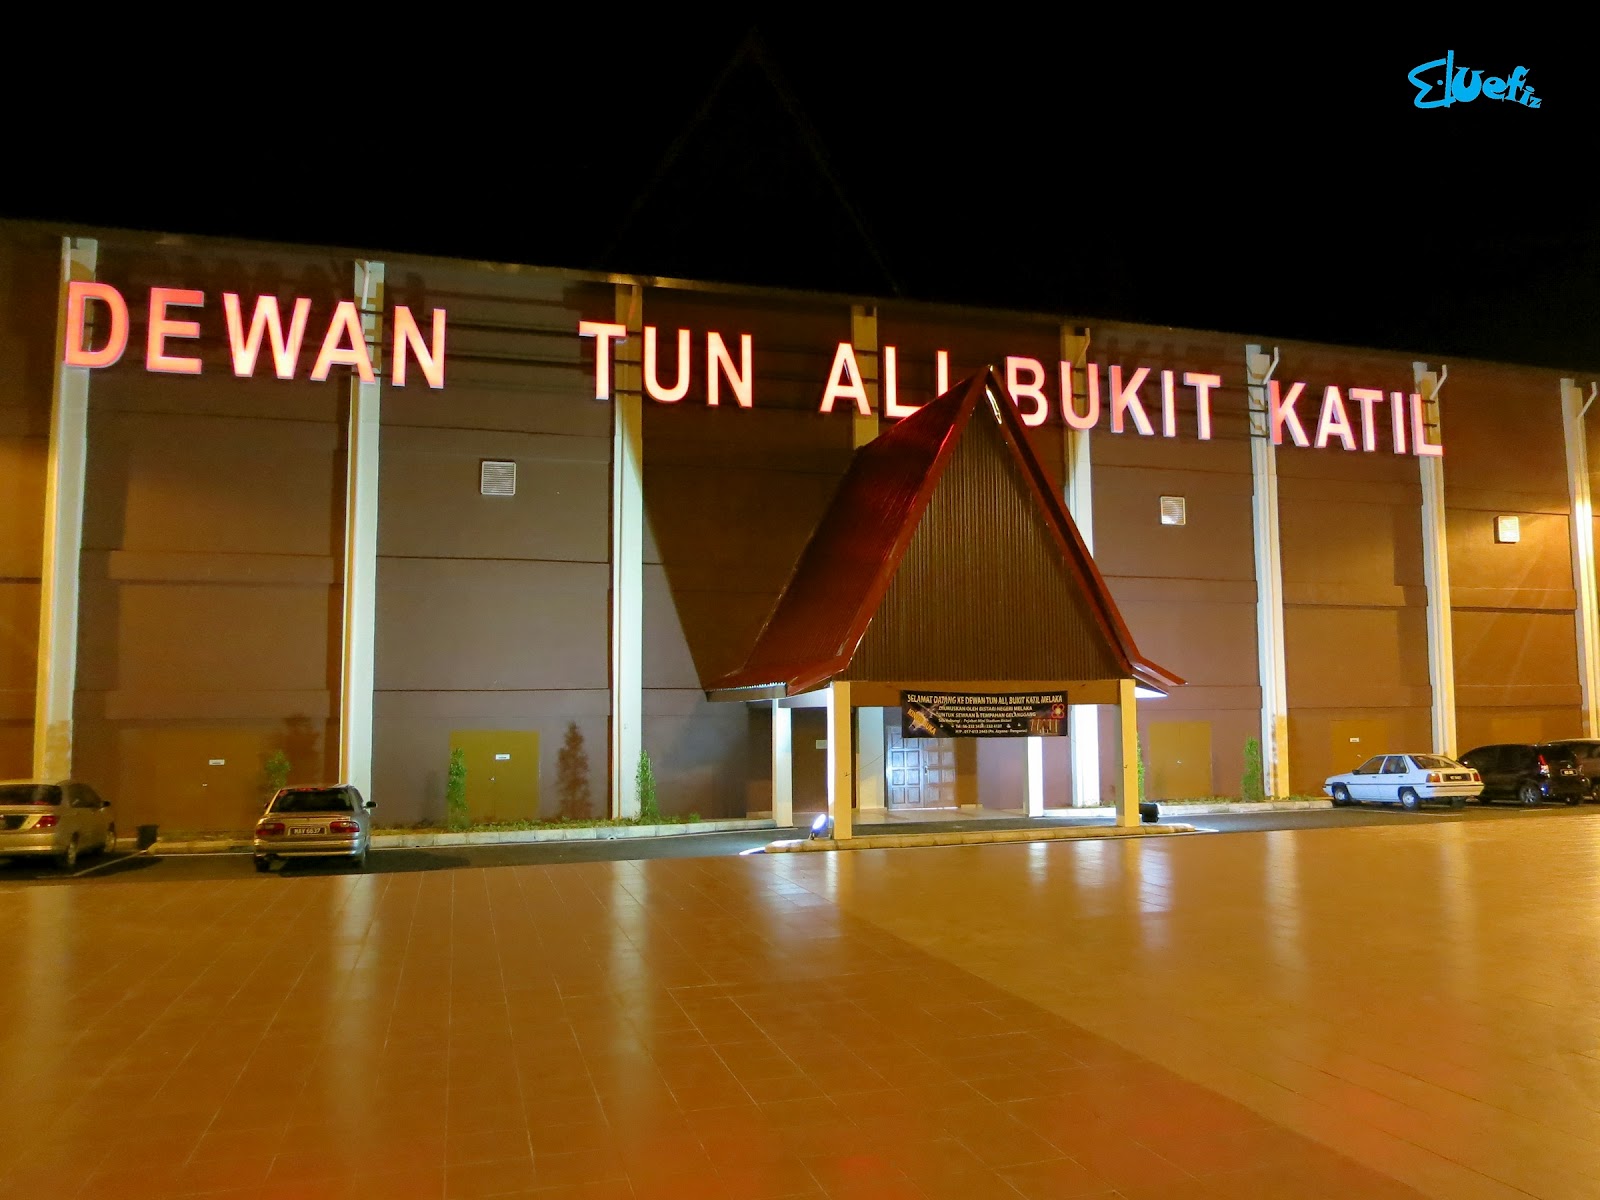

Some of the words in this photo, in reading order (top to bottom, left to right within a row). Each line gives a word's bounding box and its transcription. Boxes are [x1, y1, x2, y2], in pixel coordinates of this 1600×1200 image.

[64, 281, 447, 389] DEWAN
[578, 321, 752, 408] TUN
[819, 342, 949, 418] ALI
[1006, 355, 1221, 440] BUKIT
[1270, 379, 1443, 457] KATIL
[907, 694, 933, 703] SELAMAT
[933, 695, 956, 704] DATANG
[957, 696, 965, 704] KE
[965, 696, 985, 704] DEWAN
[985, 696, 998, 704] TUN
[1009, 696, 1026, 704] BUKIT
[1026, 696, 1041, 704] KATIL
[1041, 695, 1063, 703] MELAKA
